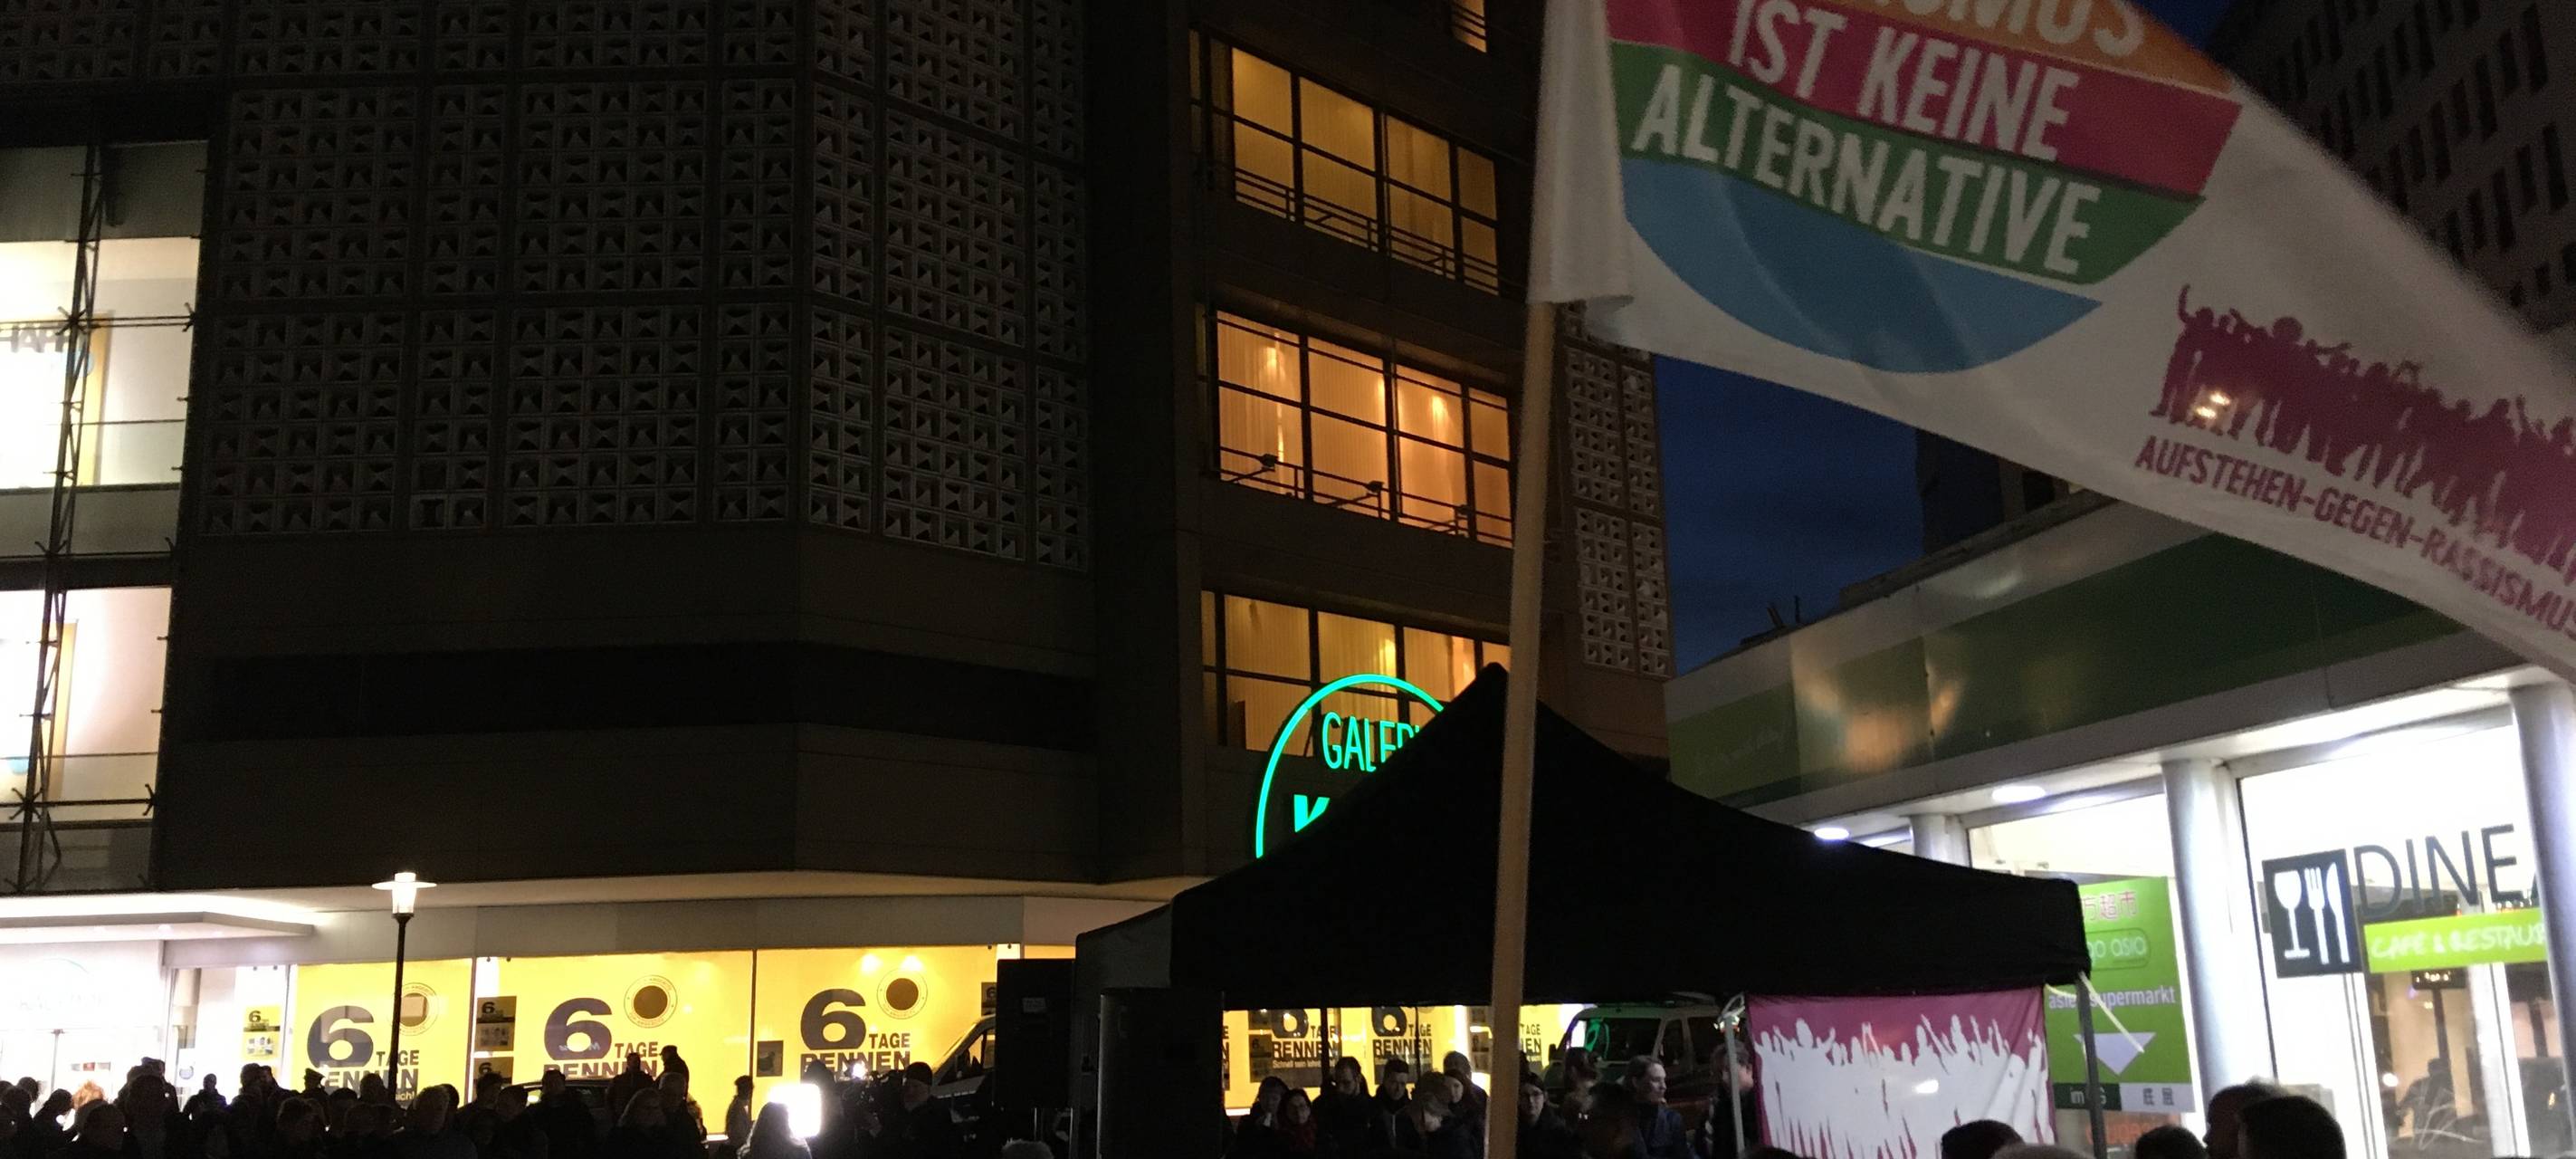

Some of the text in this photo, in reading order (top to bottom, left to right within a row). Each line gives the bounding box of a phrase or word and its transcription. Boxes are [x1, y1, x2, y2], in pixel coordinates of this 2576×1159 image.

[1728, 0, 2080, 162] IST KEINE
[1630, 62, 2103, 276] ALTERNATIVE
[2353, 823, 2540, 918] DINE
[544, 997, 613, 1060] 6
[615, 1041, 659, 1059] TAGE
[801, 988, 866, 1050] 6
[868, 1032, 911, 1049] TAGE
[2091, 984, 2176, 1011] supermarkt
[306, 1005, 375, 1069] 6
[376, 1049, 420, 1067] TGE
[1408, 1023, 1432, 1037] TGE
